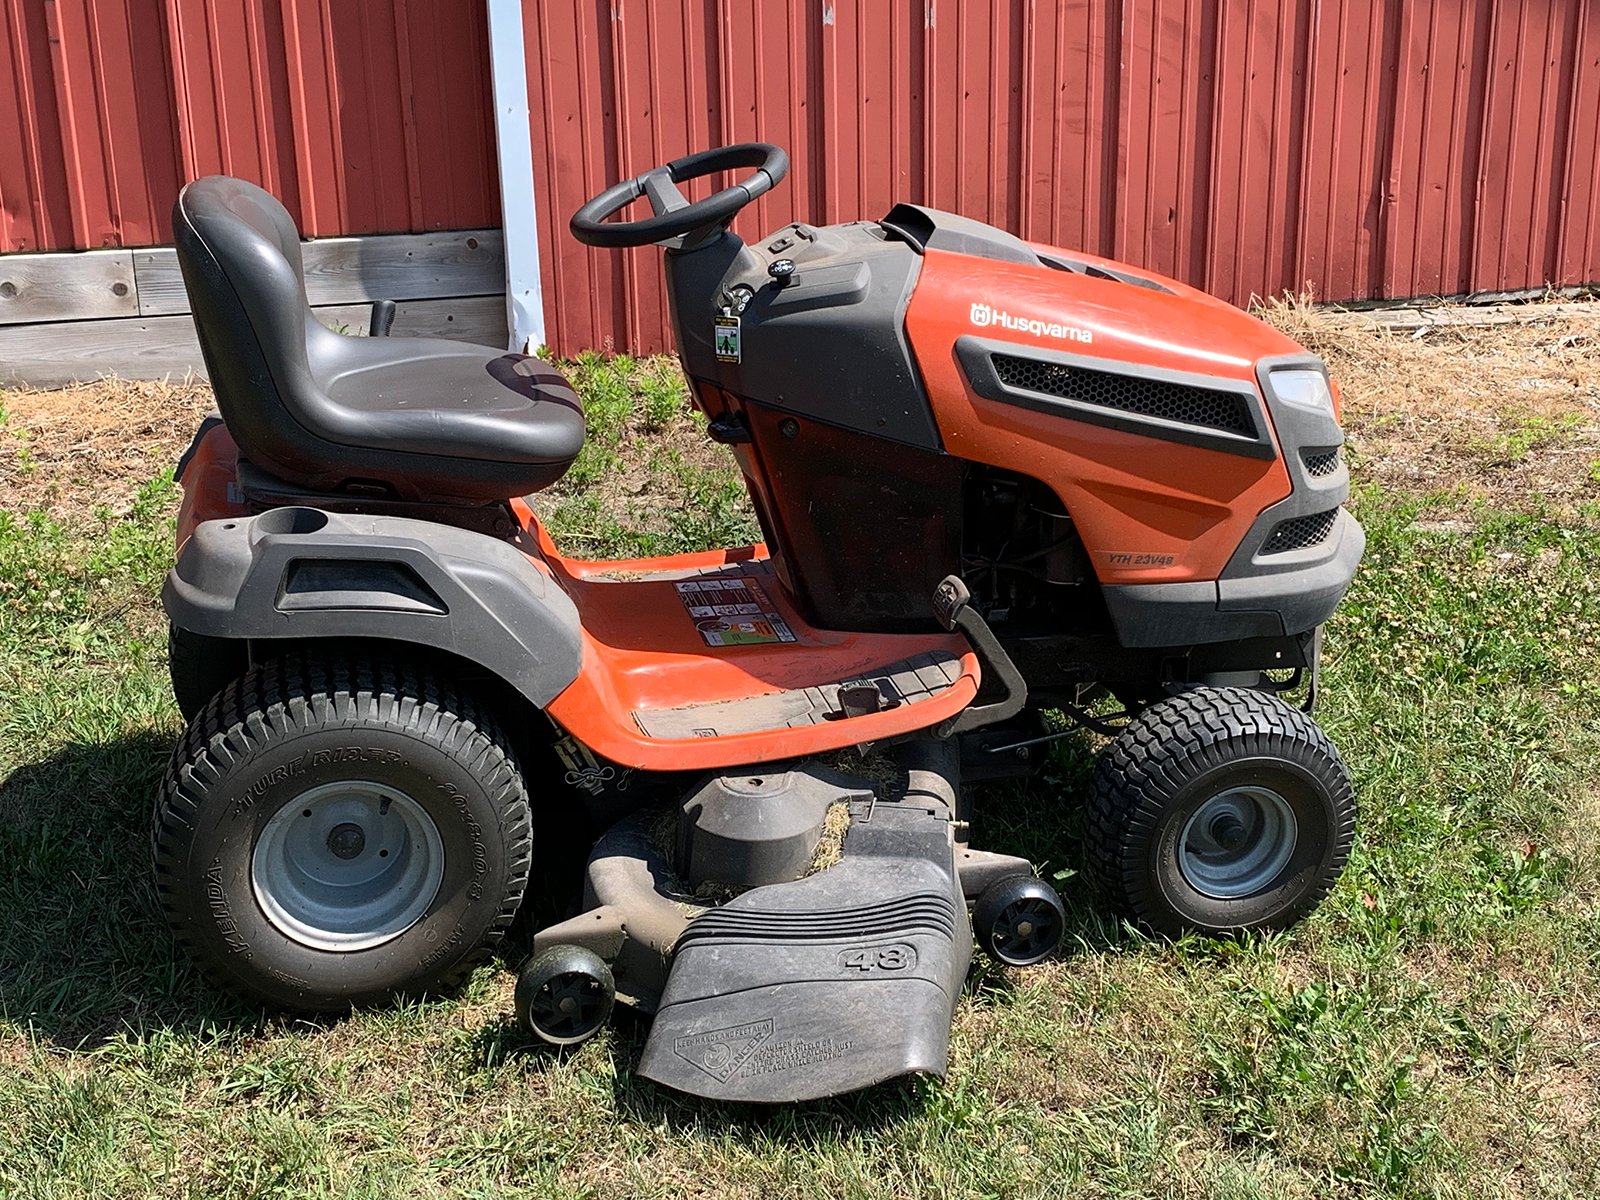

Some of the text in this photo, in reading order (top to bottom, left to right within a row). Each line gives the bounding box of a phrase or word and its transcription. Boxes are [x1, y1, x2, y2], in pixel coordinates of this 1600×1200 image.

[991, 309, 1093, 344] Husqvarna
[1109, 554, 1174, 565] YTH 23V48
[207, 865, 250, 953] KENDA
[844, 948, 909, 972] 48
[719, 1032, 765, 1079] DANGER
